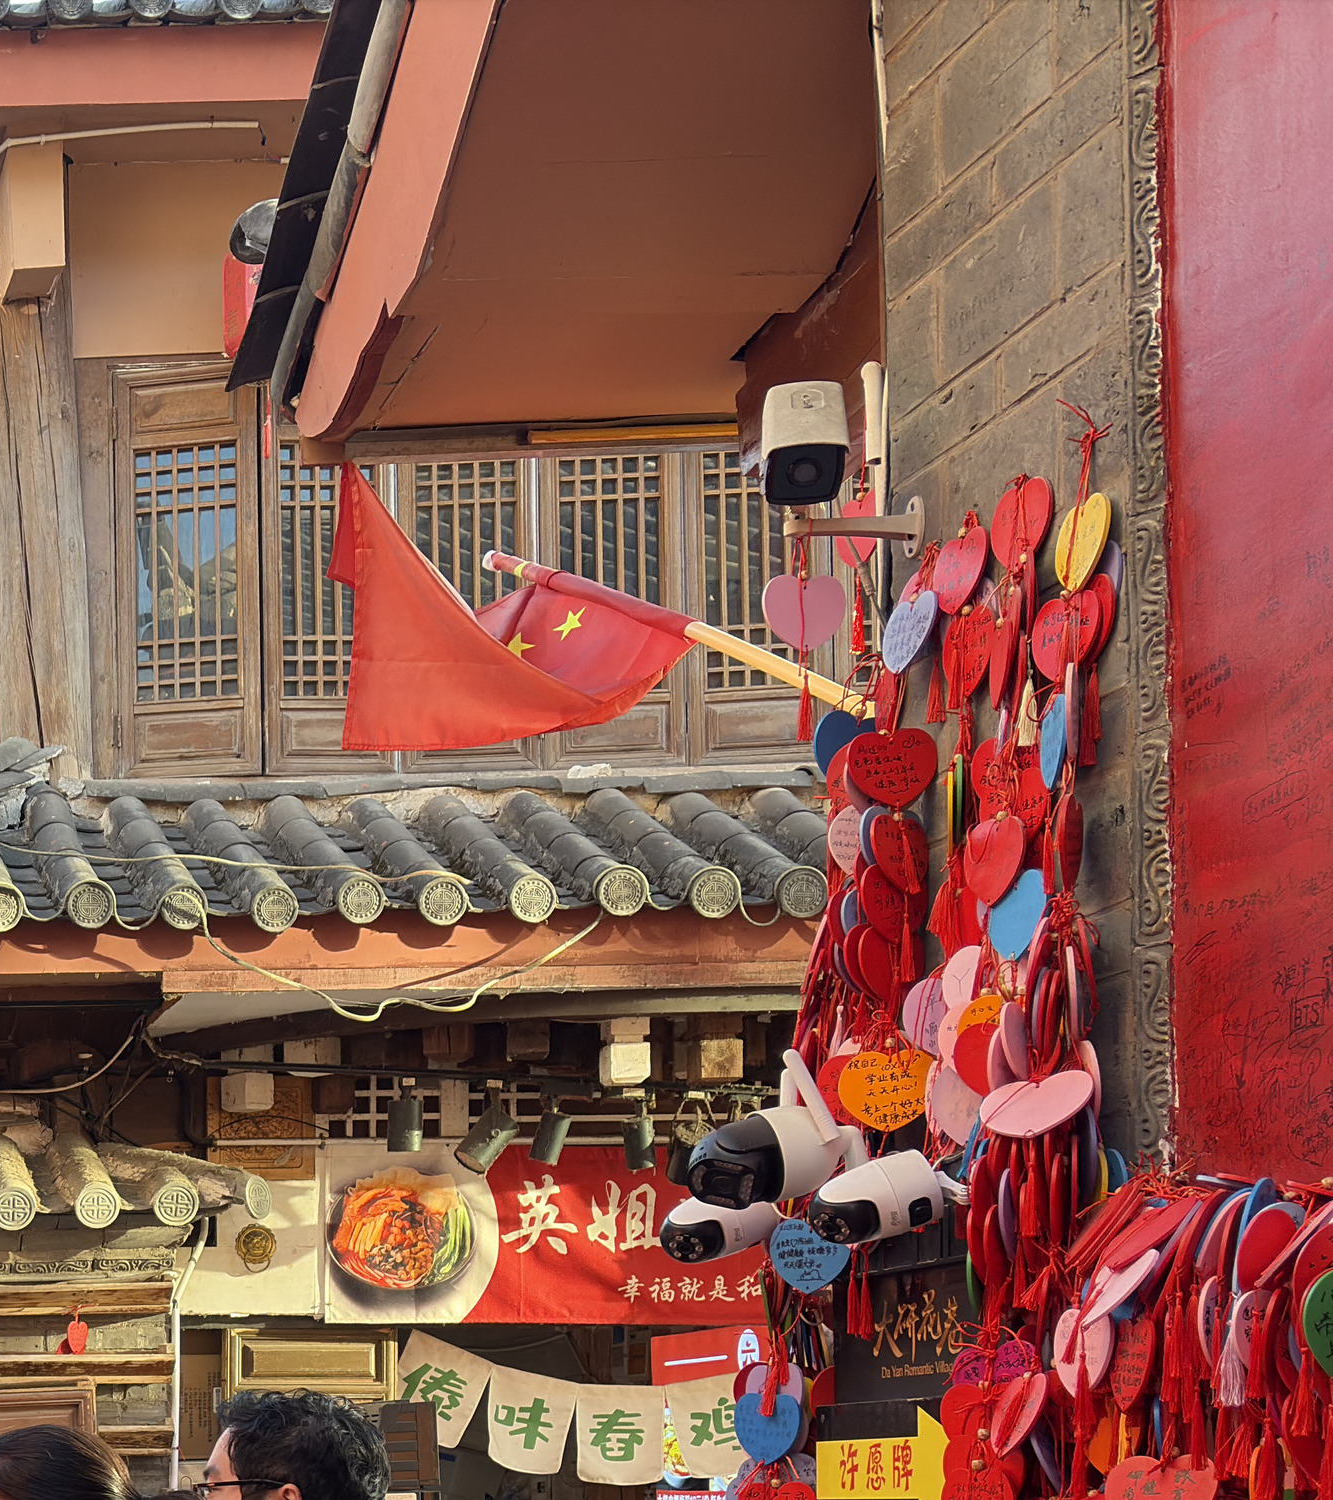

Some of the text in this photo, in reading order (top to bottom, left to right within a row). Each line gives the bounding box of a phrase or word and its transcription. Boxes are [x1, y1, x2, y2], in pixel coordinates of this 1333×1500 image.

[881, 1360, 955, 1379] Da Yan Romantic Villag
[838, 1439, 914, 1492] 许愿牌
